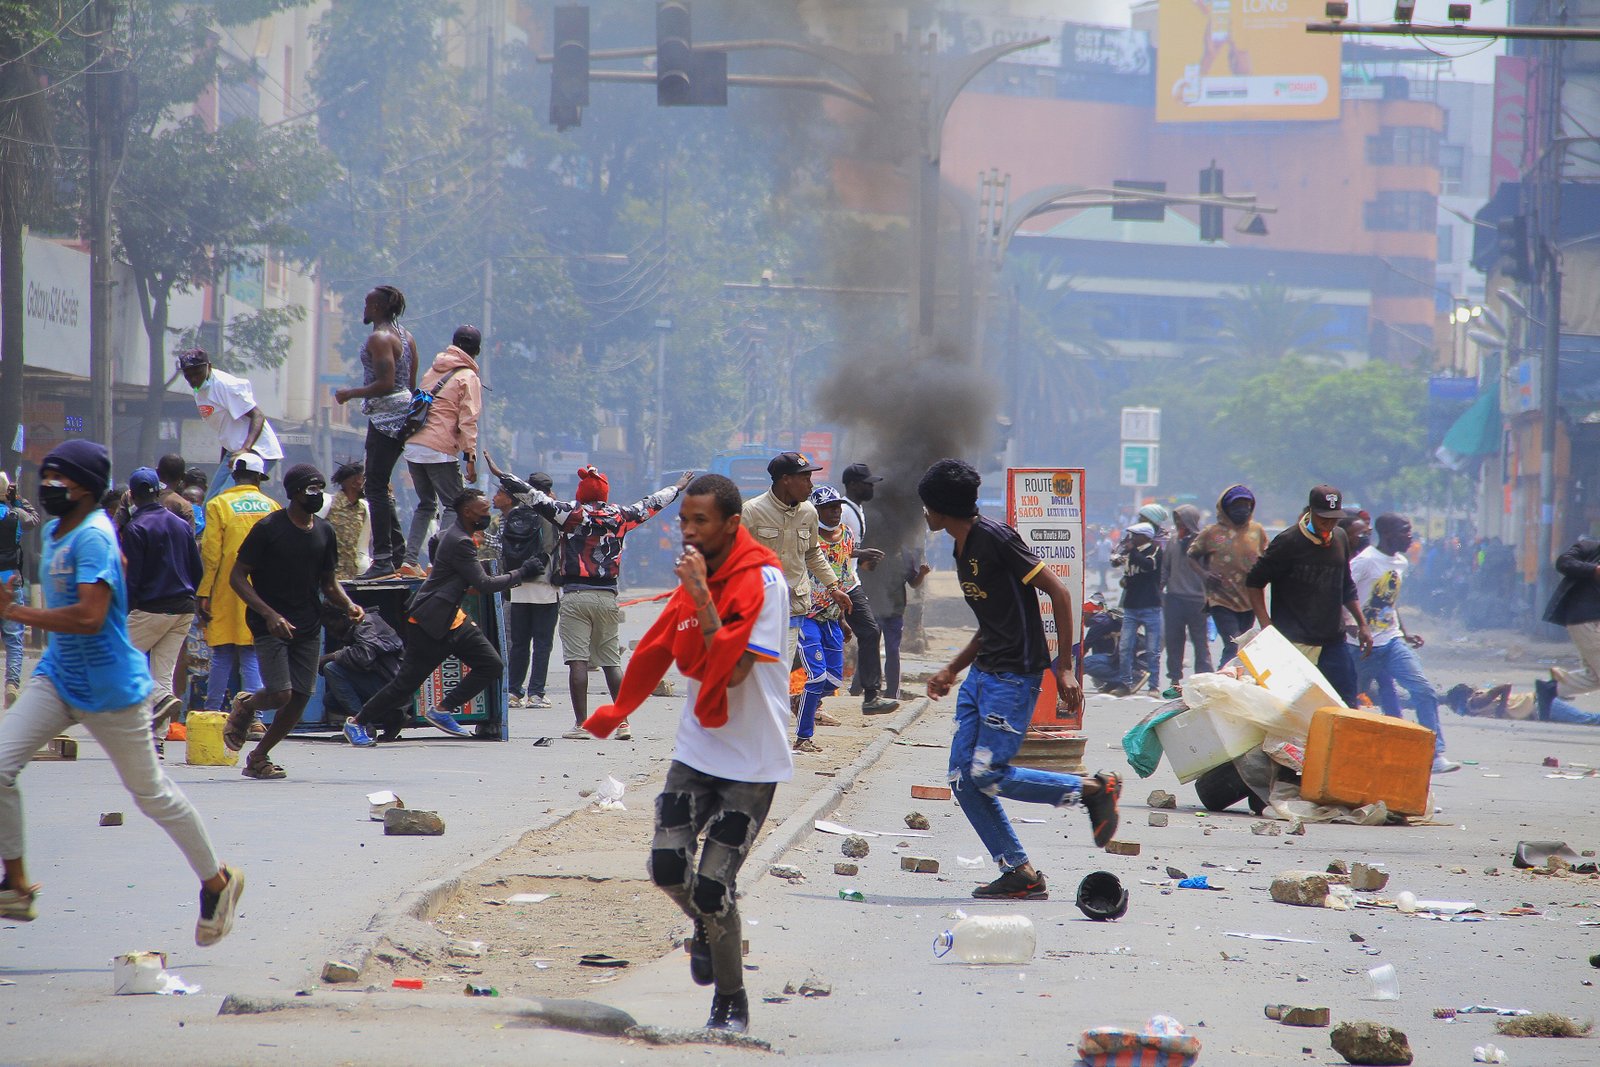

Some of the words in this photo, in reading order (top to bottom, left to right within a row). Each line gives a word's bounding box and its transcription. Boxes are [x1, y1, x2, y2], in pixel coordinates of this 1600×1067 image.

[27, 280, 50, 330] Galaxy
[60, 289, 79, 328] Series
[1025, 478, 1052, 492] ROUTE
[1021, 496, 1039, 506] KMO
[1051, 496, 1073, 505] DIGITAL
[1018, 507, 1043, 517] SACCO
[1032, 531, 1043, 539] New
[1043, 530, 1057, 540] Route
[1058, 530, 1069, 540] Alert
[1048, 565, 1070, 577] GEMI
[1041, 602, 1054, 614] KIN
